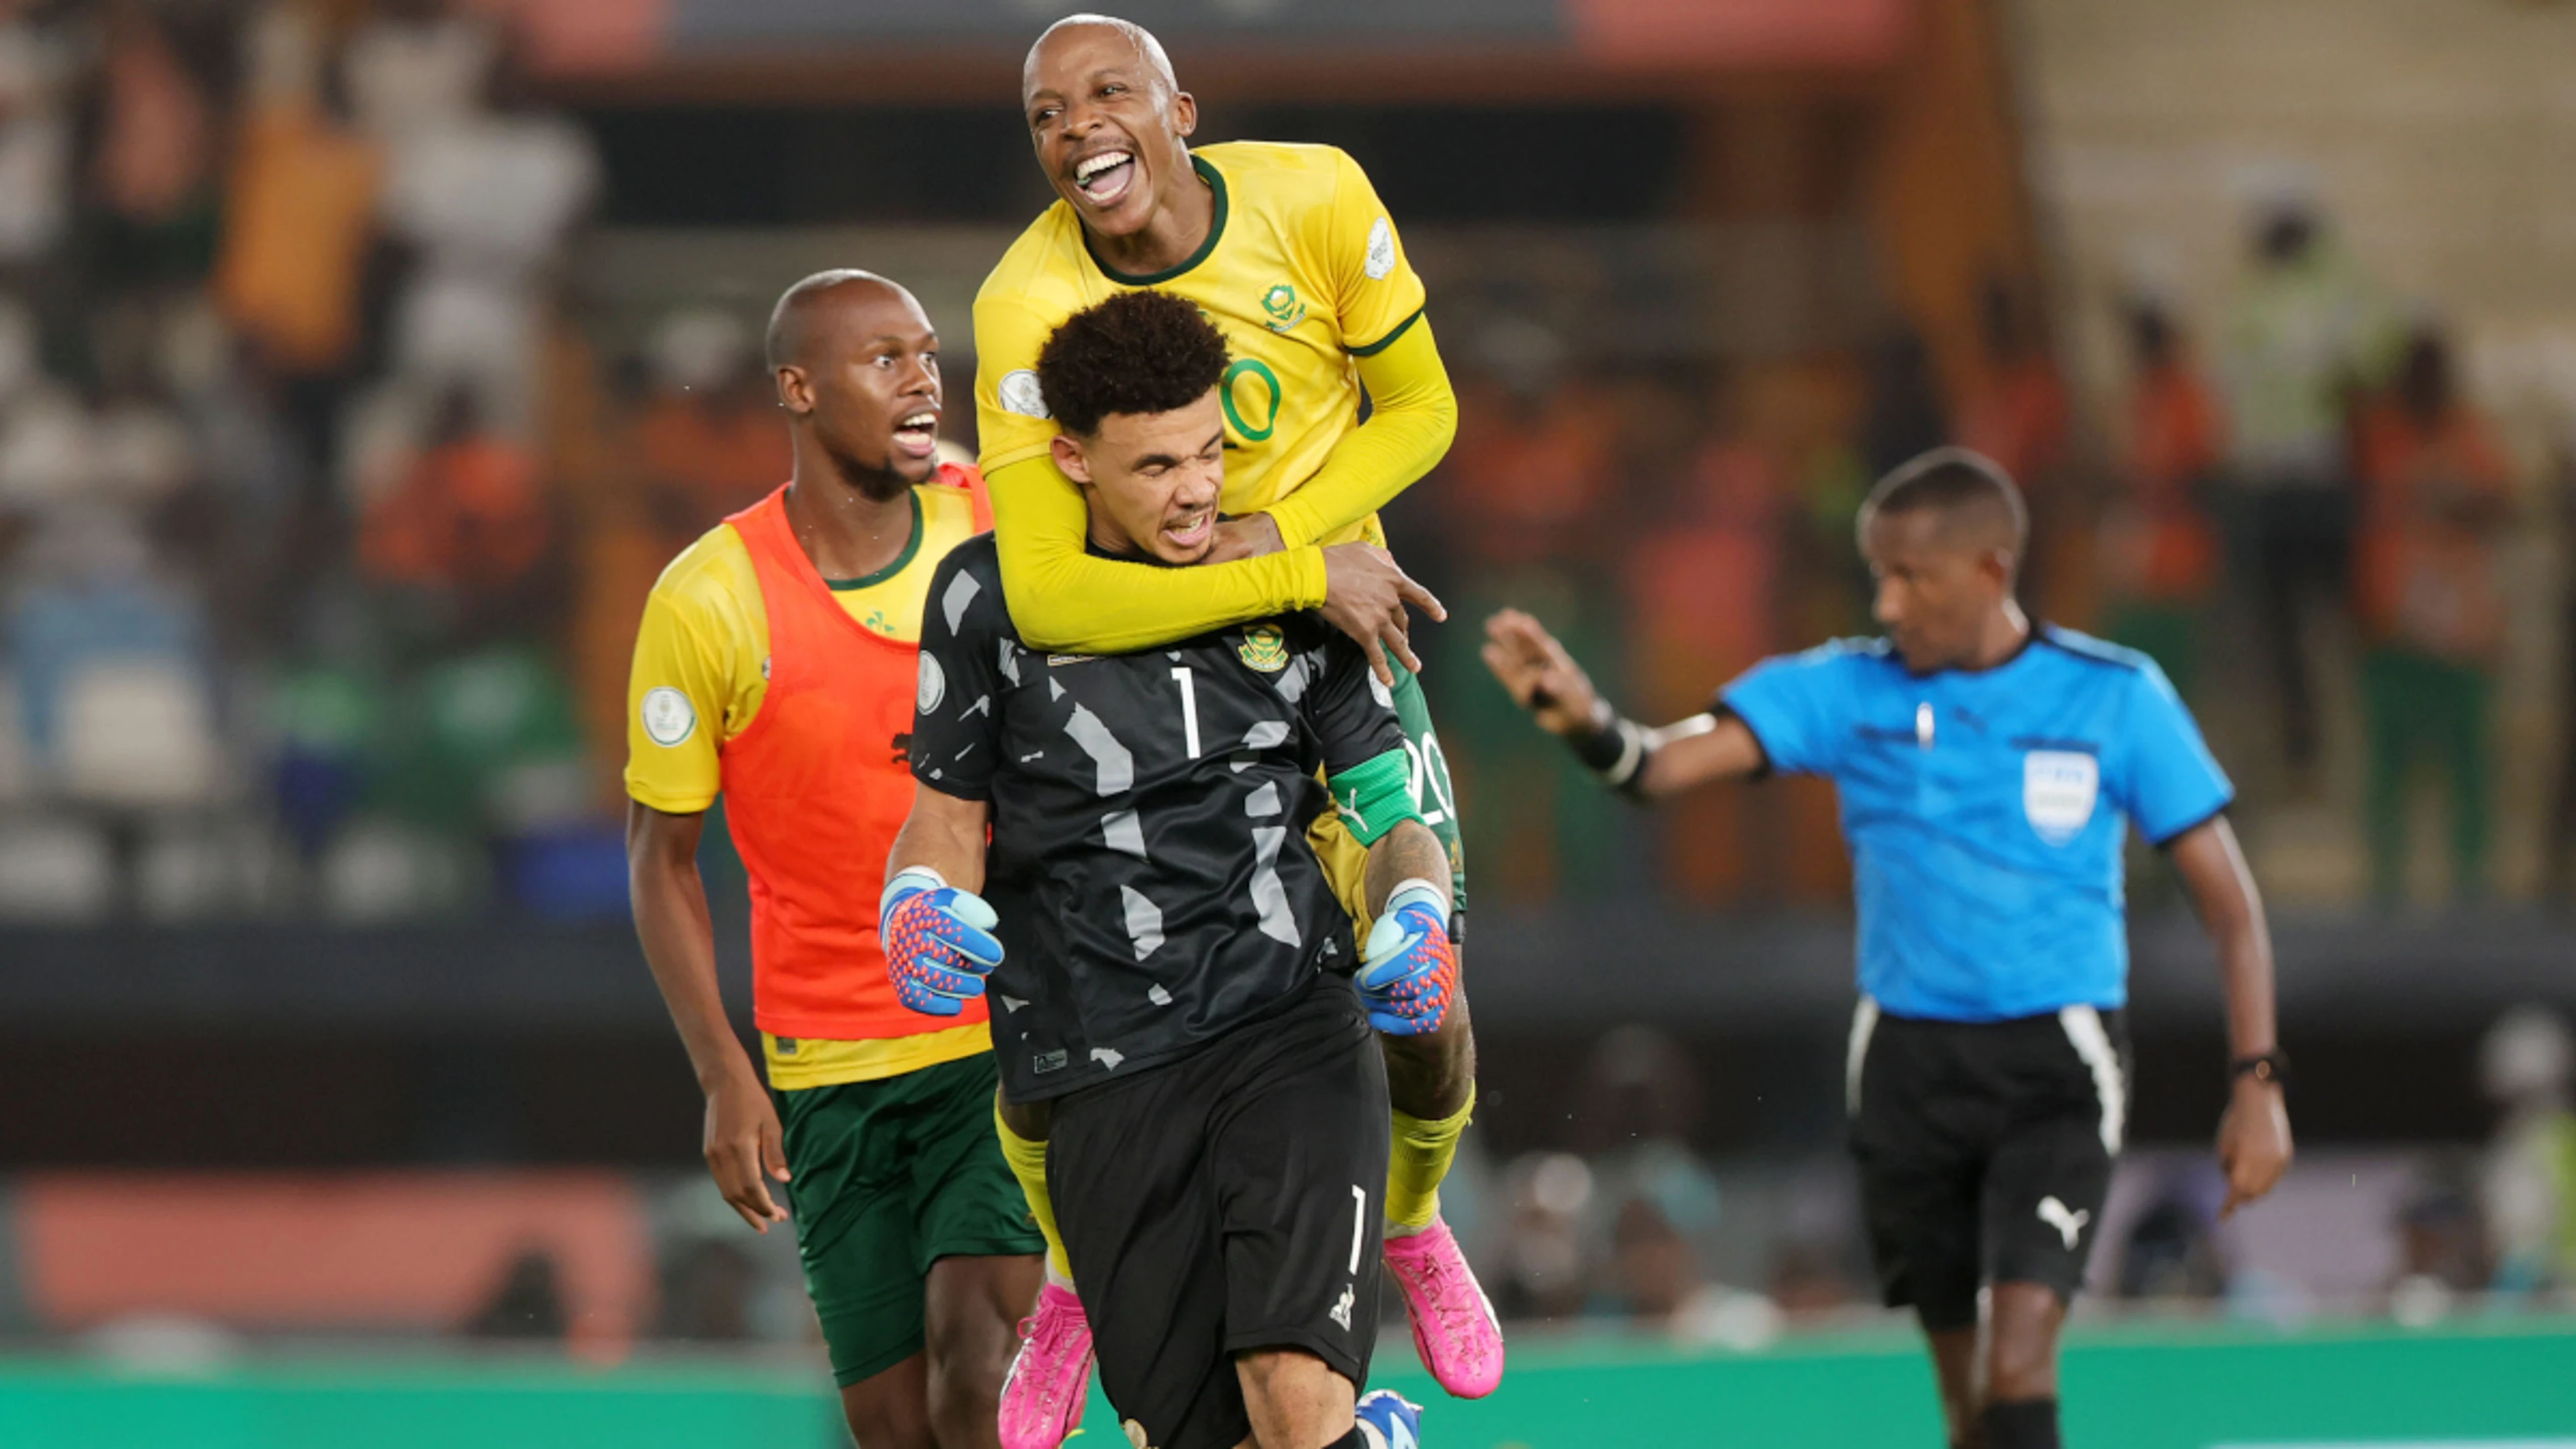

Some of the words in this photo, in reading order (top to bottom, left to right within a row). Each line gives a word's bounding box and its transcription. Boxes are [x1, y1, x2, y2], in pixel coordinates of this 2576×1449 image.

[1221, 358, 1281, 443] 0
[1171, 667, 1201, 759] 1
[1403, 731, 1454, 823] 20
[1348, 1184, 1366, 1276] 1
